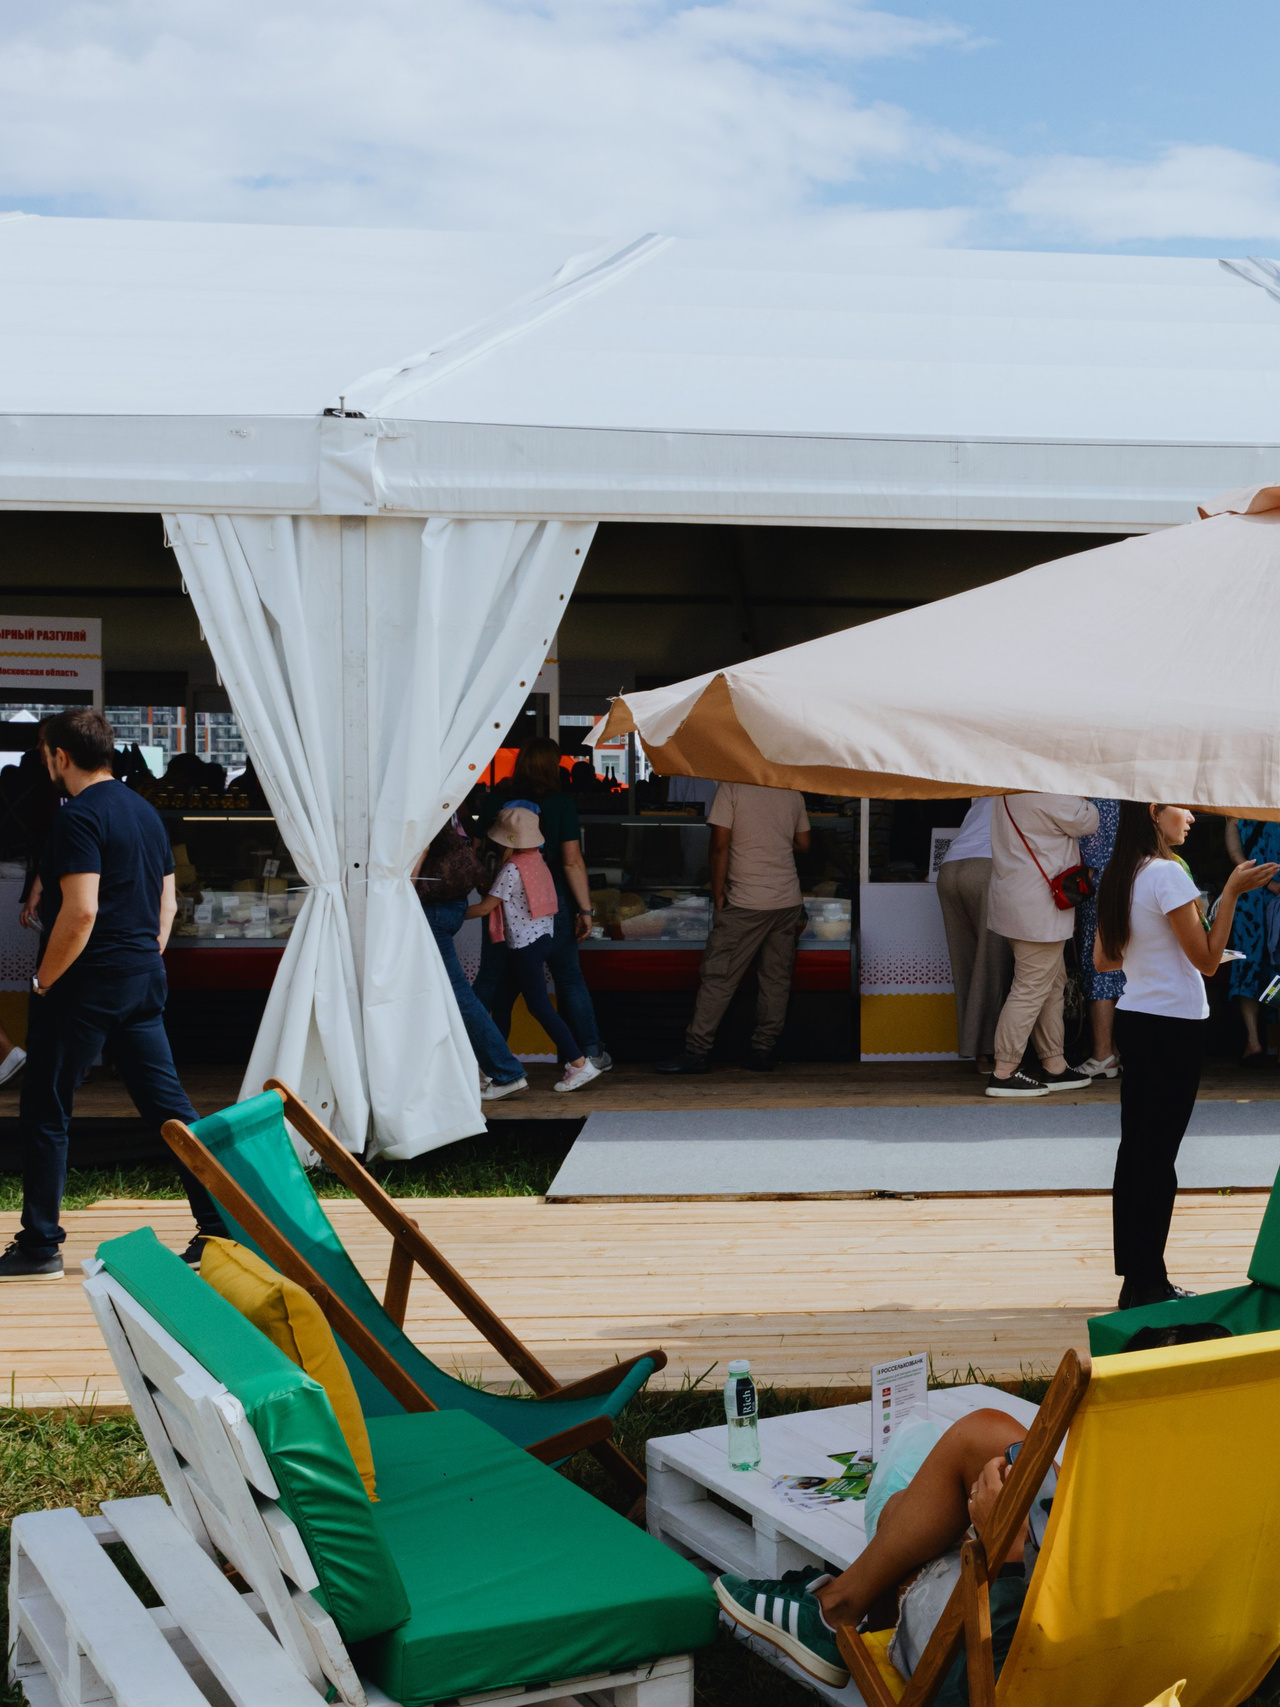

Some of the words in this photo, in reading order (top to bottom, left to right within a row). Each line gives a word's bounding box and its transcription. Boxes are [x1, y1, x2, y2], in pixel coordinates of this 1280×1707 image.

[36, 630, 87, 642] РАЗГУЛЯЙ
[45, 668, 79, 677] область
[742, 1390, 752, 1414] Rich
